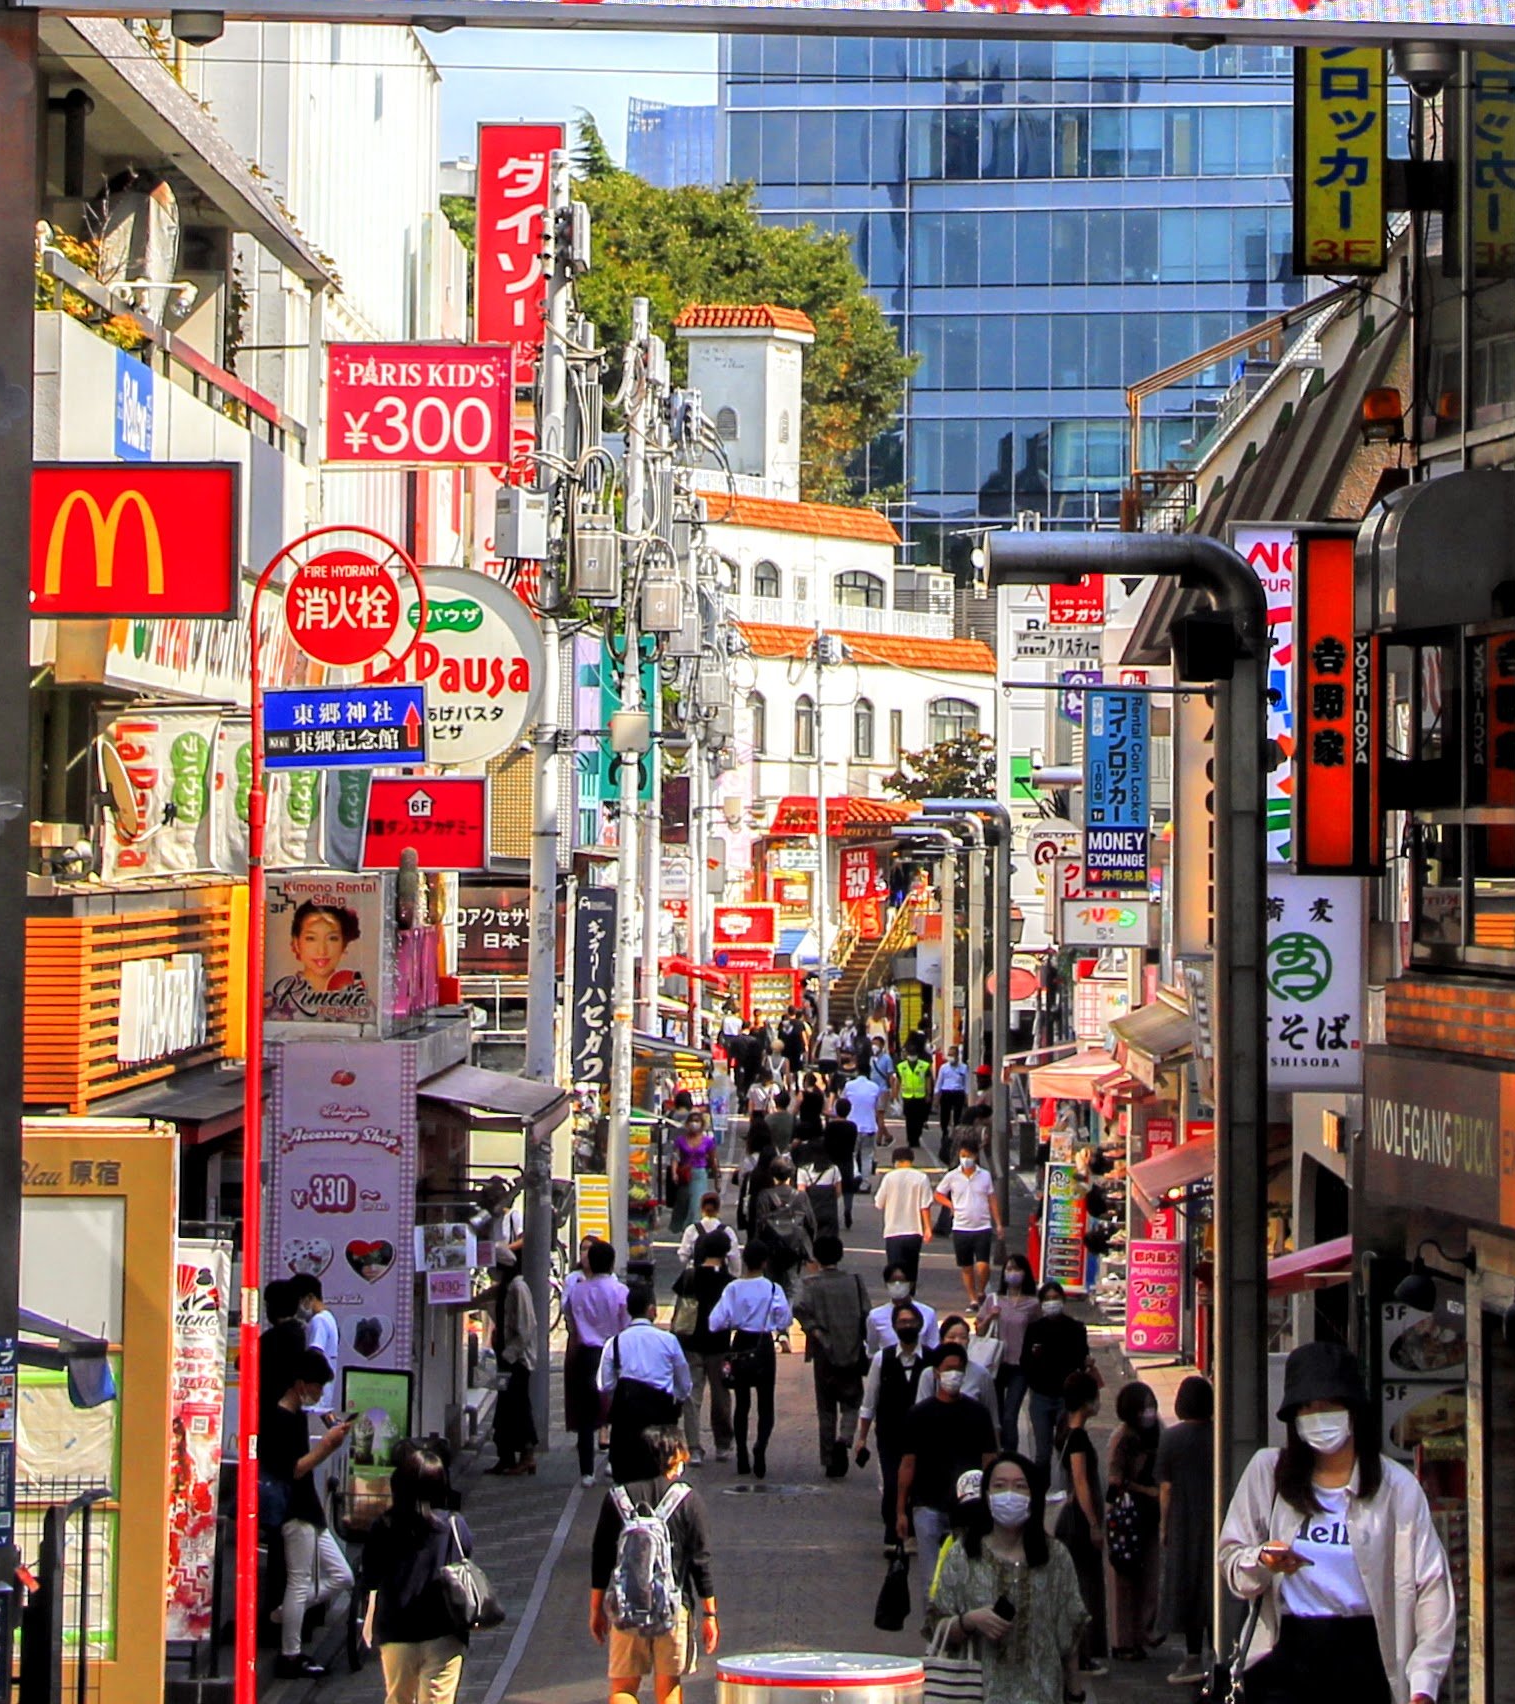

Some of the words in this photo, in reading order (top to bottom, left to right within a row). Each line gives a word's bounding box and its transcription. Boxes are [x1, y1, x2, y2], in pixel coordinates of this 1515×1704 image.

[493, 151, 547, 328] ダイソー
[428, 363, 496, 388] KID'S
[343, 395, 493, 456] ¥300
[304, 564, 328, 579] FIRE
[331, 563, 381, 579] HYDRANT
[295, 585, 393, 631] 消火栓
[1062, 608, 1104, 623] アガサ
[414, 642, 531, 700] Pausa
[292, 700, 394, 725] 東郷神社
[1313, 636, 1347, 767] 吉野家
[1355, 641, 1369, 765] YOSHINOYA
[1130, 696, 1143, 740] Rental
[292, 727, 400, 754] 東郷記念館
[1108, 696, 1128, 823] コインロッカー
[1131, 745, 1142, 773] Coin
[411, 800, 430, 813] 6F
[1131, 777, 1143, 824] Locker
[1088, 831, 1146, 851] MONEY
[846, 851, 870, 865] SALE
[1087, 853, 1146, 868] EXCHANGE
[283, 881, 333, 895] Kimono
[336, 880, 377, 894] Rental
[272, 975, 368, 1017] Kimono
[575, 986, 609, 1082] ハセガワ
[287, 1128, 359, 1144] Accessory
[361, 1127, 398, 1148] Shop
[1370, 1098, 1453, 1170] WOLFGANG
[1453, 1121, 1495, 1178] PUCK
[69, 1159, 122, 1187] 原宿
